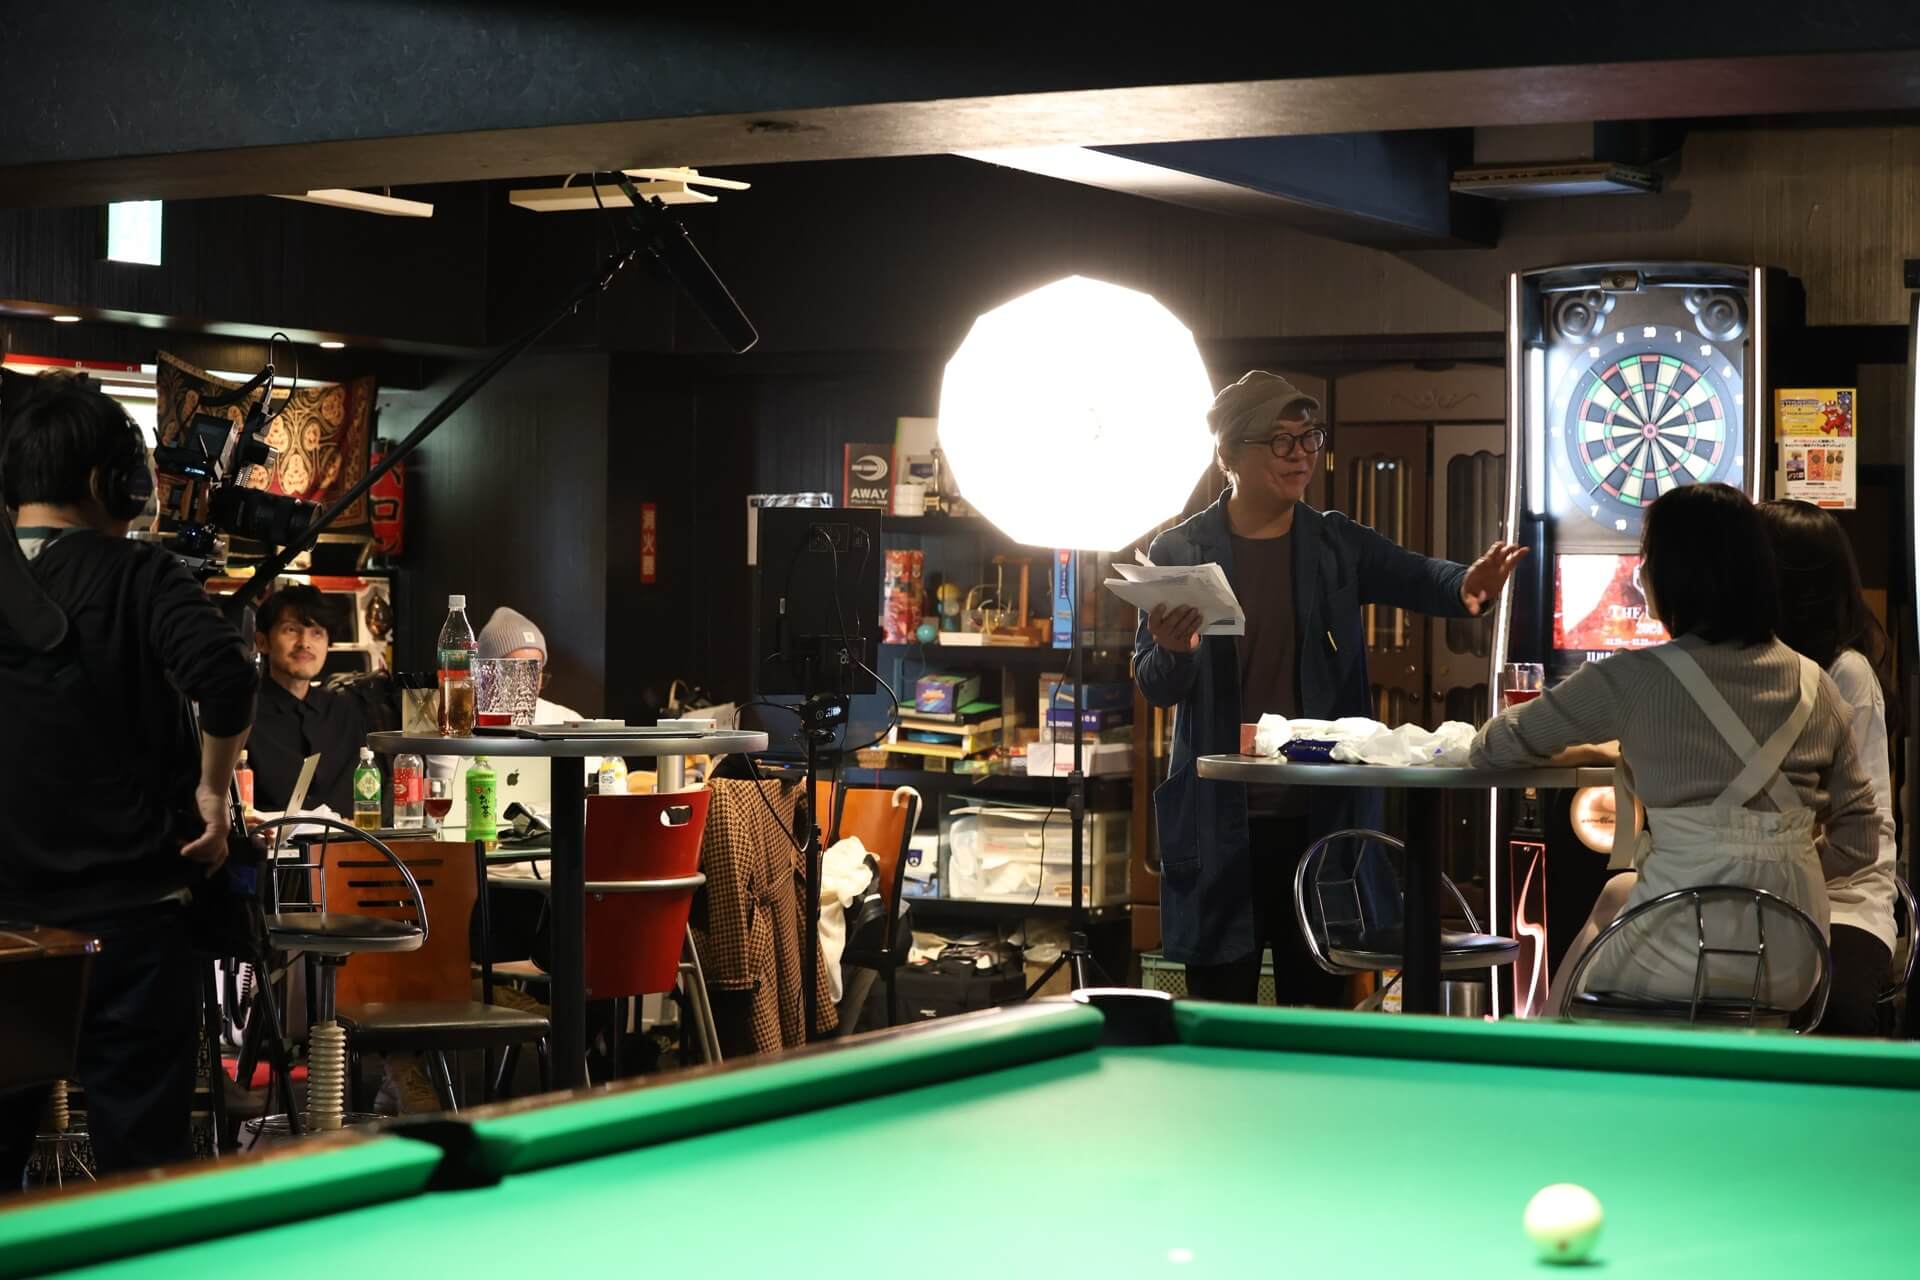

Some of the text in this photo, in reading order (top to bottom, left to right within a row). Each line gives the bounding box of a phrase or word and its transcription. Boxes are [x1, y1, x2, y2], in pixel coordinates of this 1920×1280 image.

[1643, 326, 1657, 338] 20
[851, 488, 888, 499] AWAY
[1590, 505, 1599, 517] 7
[1608, 605, 1641, 620] THE
